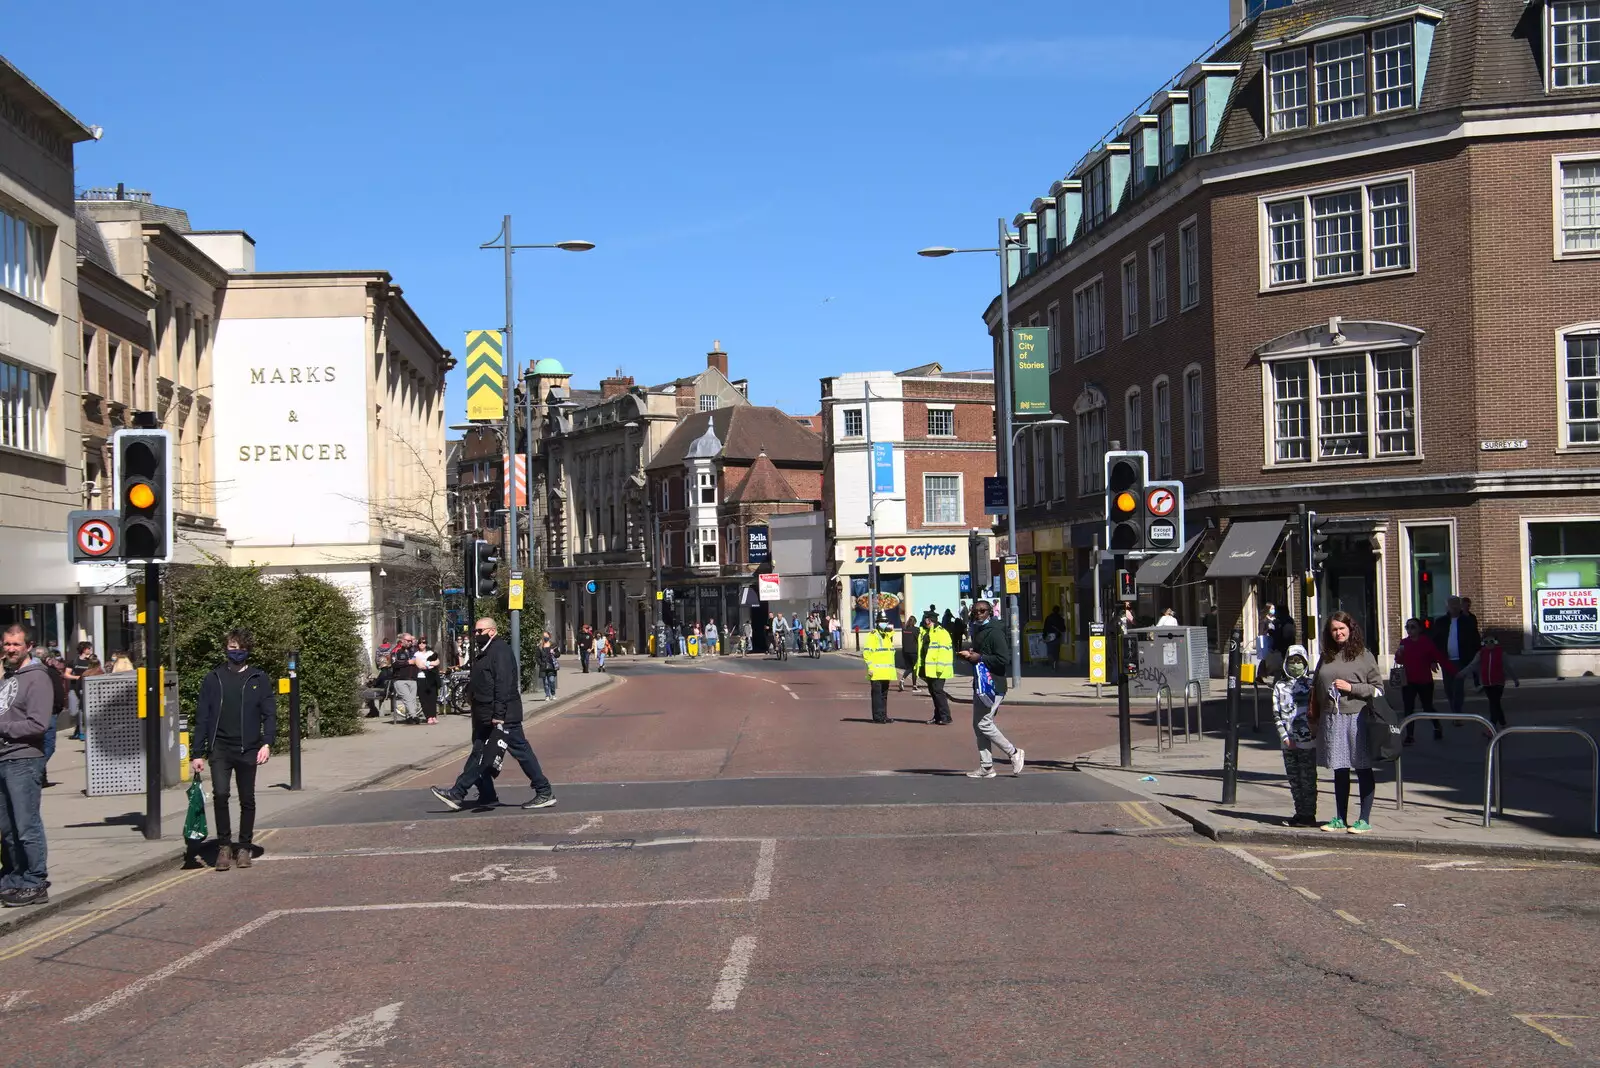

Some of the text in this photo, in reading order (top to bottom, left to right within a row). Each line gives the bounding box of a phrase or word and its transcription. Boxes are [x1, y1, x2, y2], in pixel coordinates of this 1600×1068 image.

[1018, 342, 1034, 351] City
[1019, 351, 1027, 359] of
[1019, 361, 1044, 369] Stories
[250, 366, 336, 384] MARKS
[288, 410, 299, 422] &
[1484, 441, 1511, 449] SURREY
[239, 444, 347, 462] SPENCER
[750, 542, 767, 550] Italia
[855, 544, 956, 559] TESCO express
[1569, 597, 1598, 606] SALE
